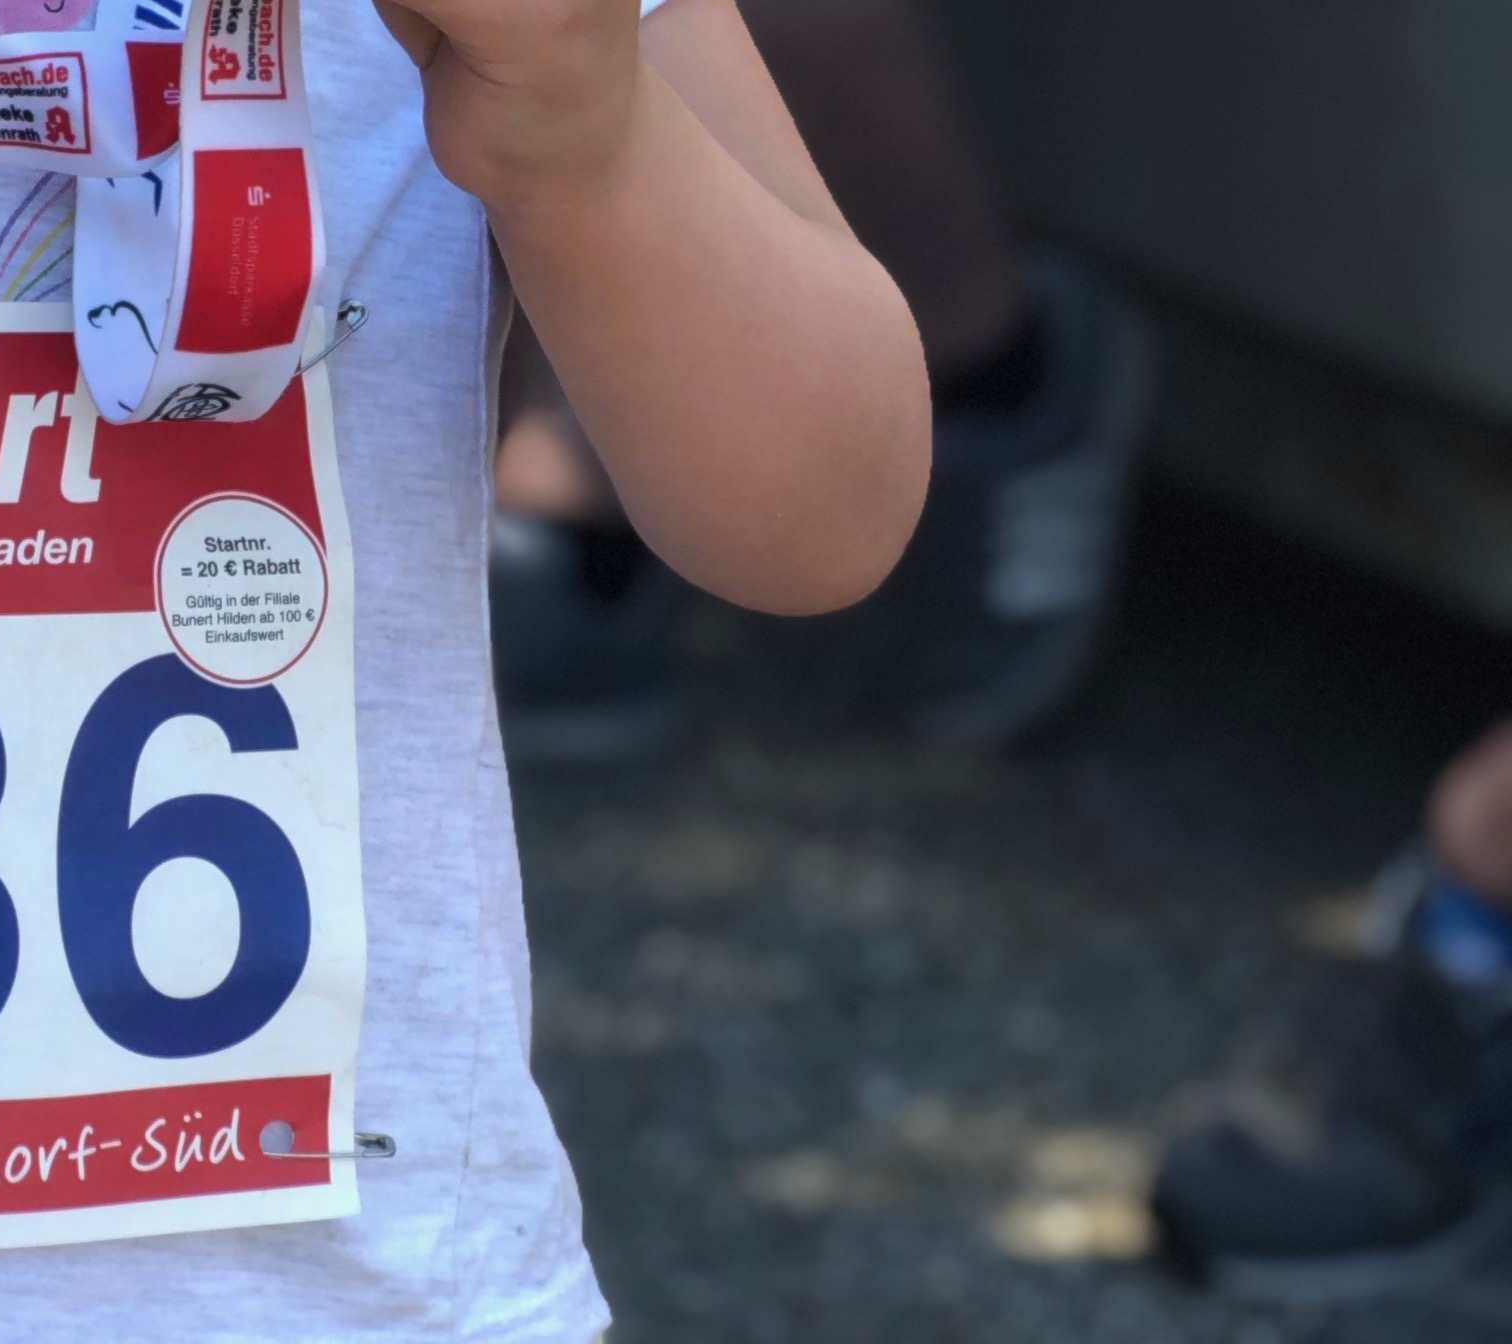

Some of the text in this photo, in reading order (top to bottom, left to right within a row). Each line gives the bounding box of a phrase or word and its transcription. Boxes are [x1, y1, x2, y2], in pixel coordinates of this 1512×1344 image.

[203, 537, 272, 553] Startnr.
[197, 560, 219, 577] 20
[224, 559, 238, 577] €
[242, 558, 302, 576] Rabatt
[185, 592, 301, 611] Gültig in der Filiale
[172, 608, 316, 627] Bunert Hilden ab 100 €
[204, 628, 285, 644] Einkaufswert
